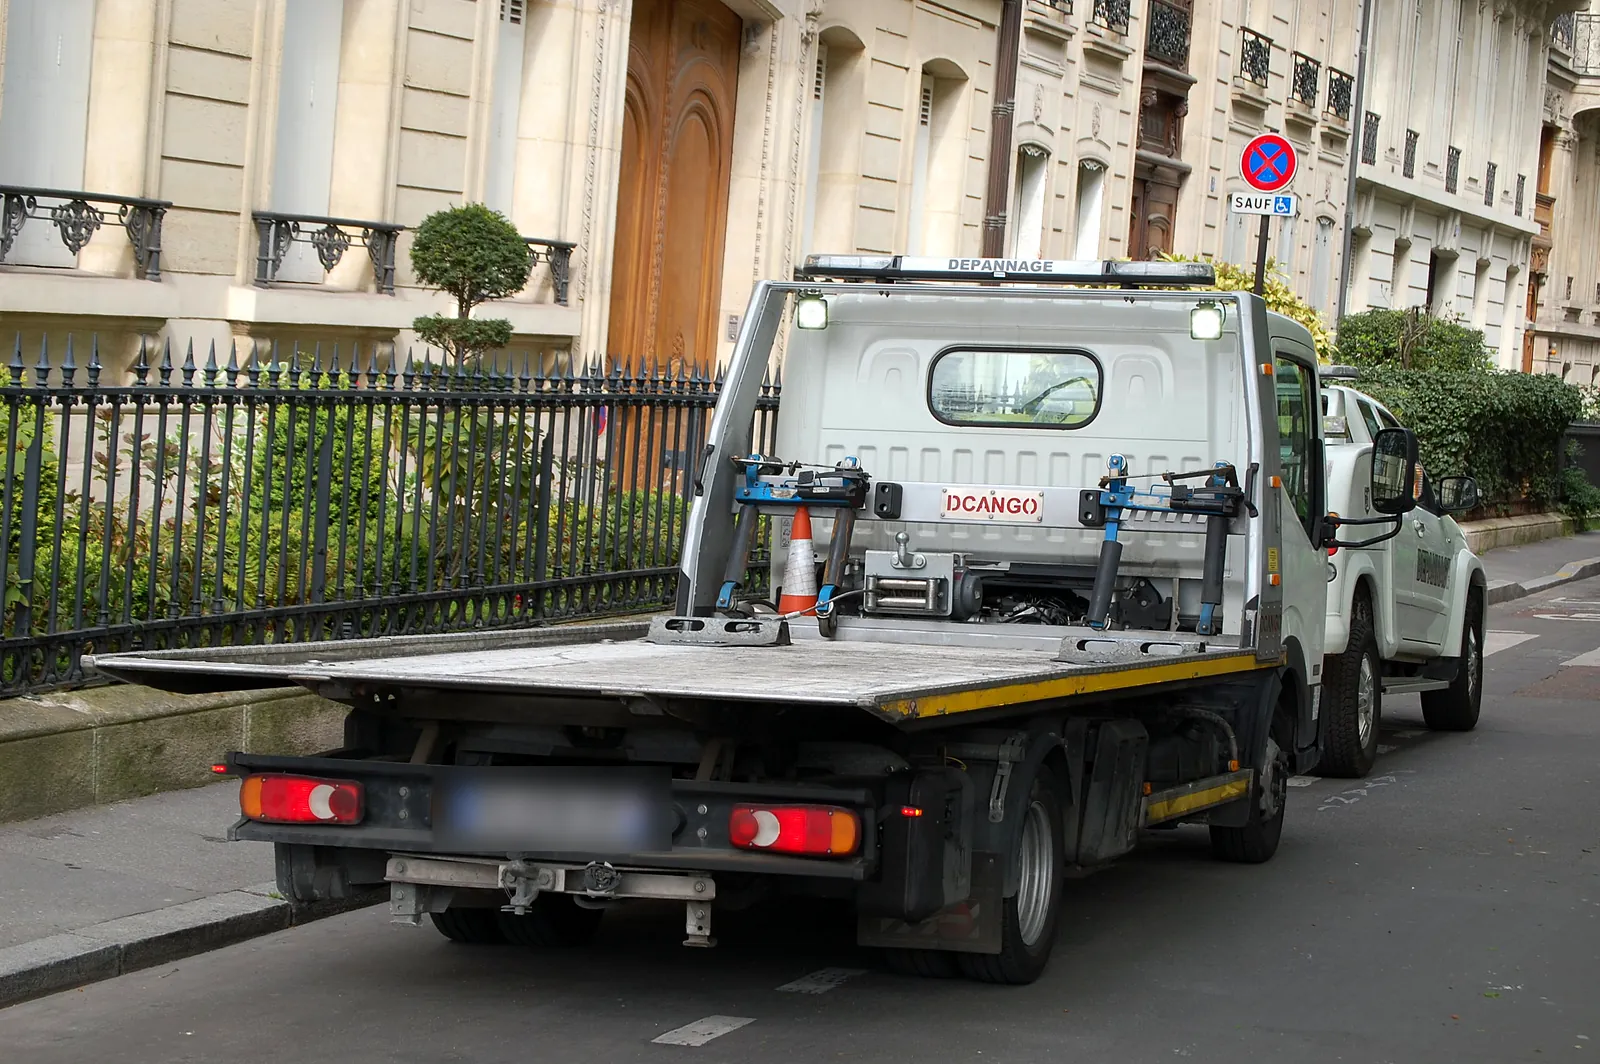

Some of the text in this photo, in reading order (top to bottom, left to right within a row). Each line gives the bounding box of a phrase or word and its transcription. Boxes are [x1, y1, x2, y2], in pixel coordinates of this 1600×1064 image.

[1235, 196, 1272, 210] SAUF
[948, 259, 1054, 272] DEPANNAGE
[946, 494, 1038, 515] DCANGO
